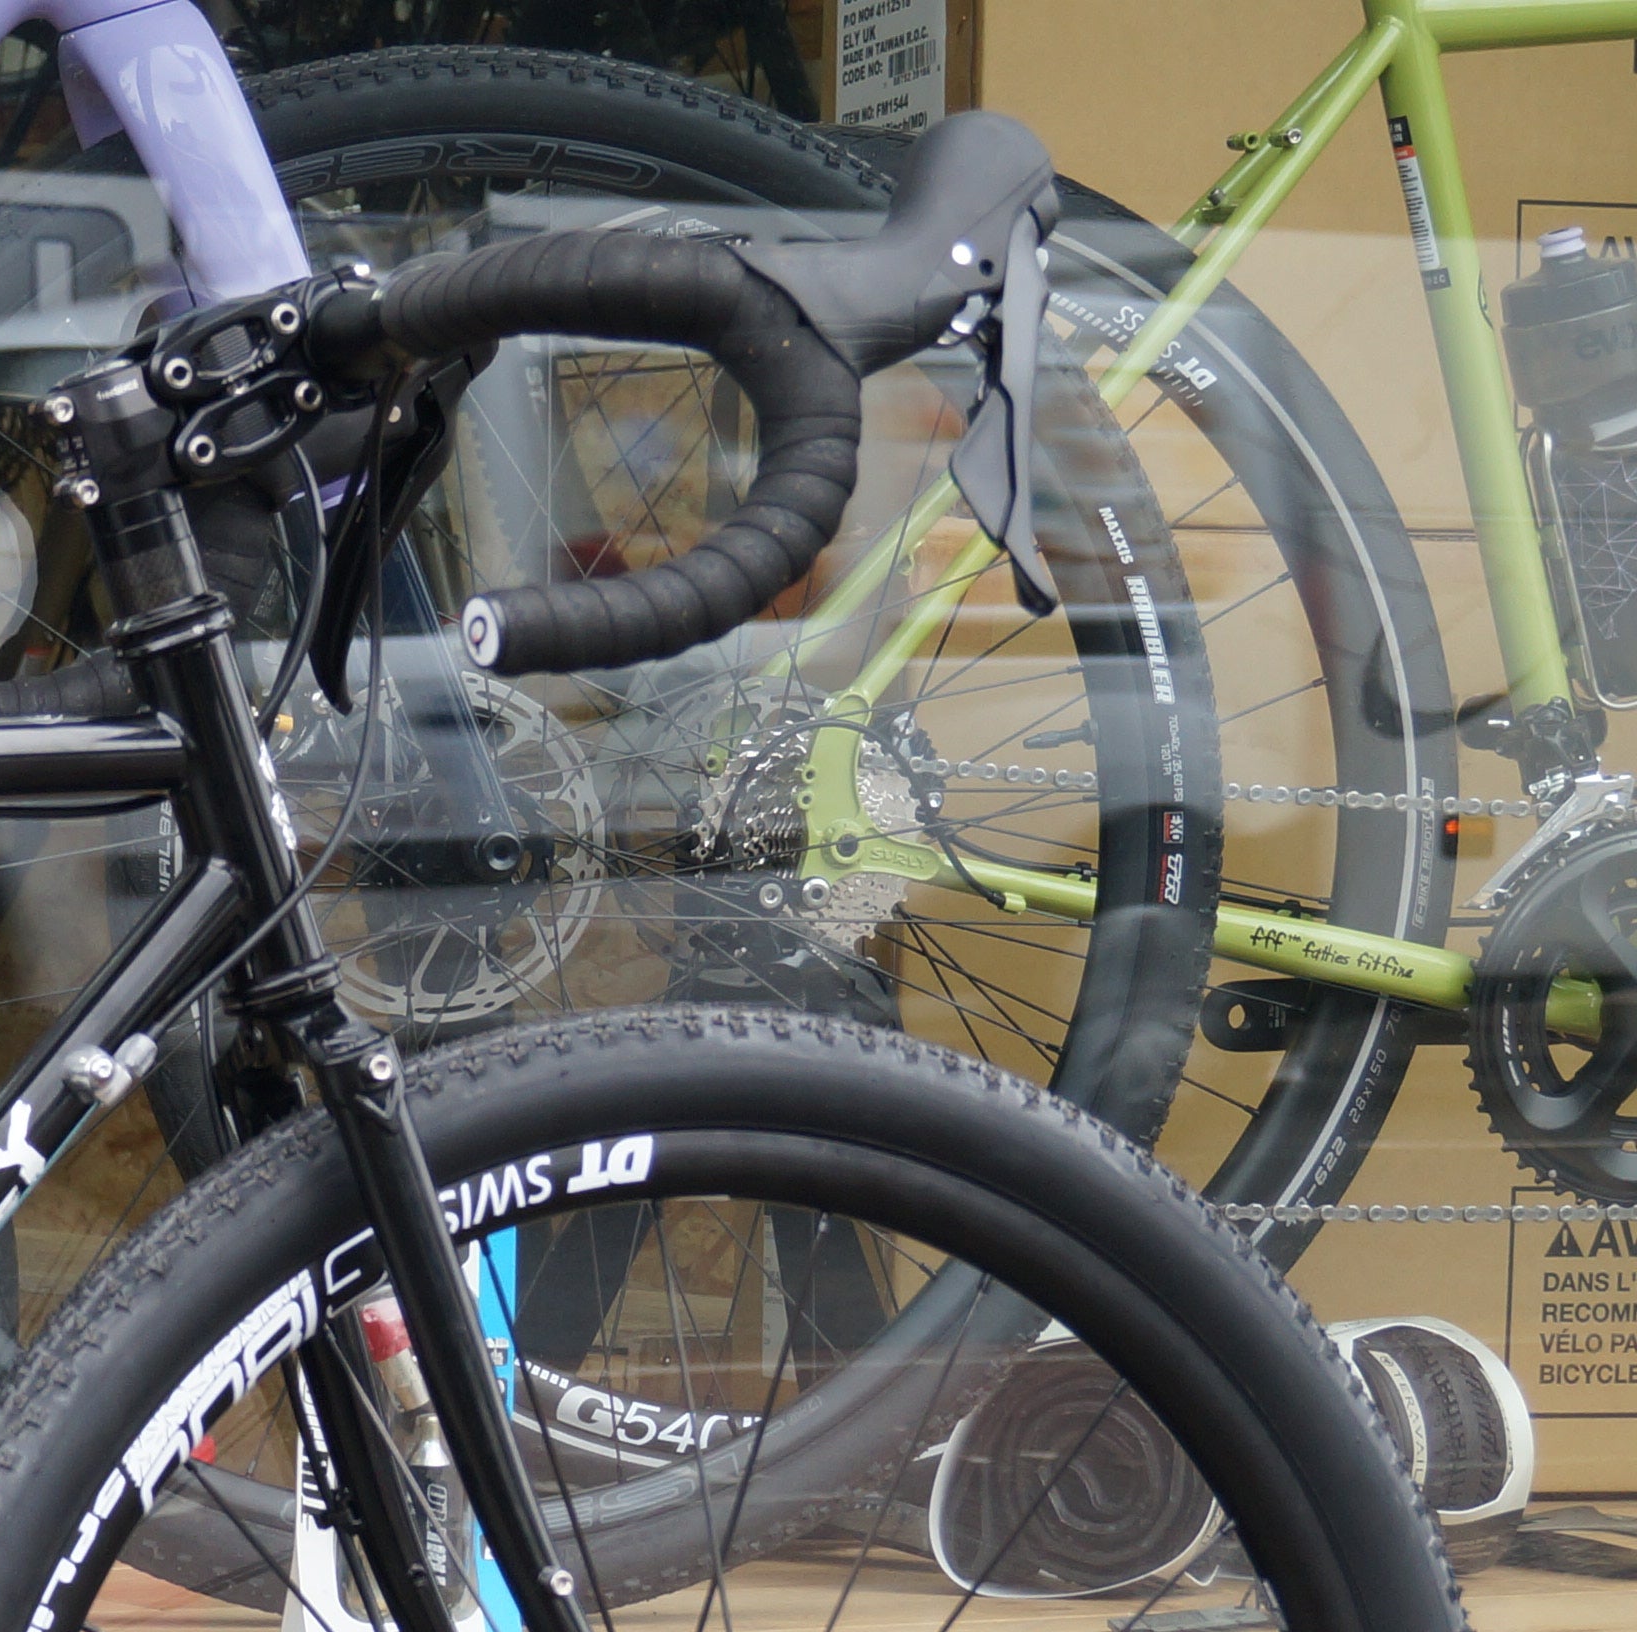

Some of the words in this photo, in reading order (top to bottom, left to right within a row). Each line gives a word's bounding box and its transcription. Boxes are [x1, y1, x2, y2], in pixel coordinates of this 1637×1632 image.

[843, 31, 859, 50] ELY
[863, 25, 876, 42] UK
[843, 49, 863, 66] MADE
[865, 46, 873, 58] IN
[876, 34, 904, 56] TAIWAN
[842, 65, 866, 86] CODE
[868, 60, 883, 78] NO:
[1113, 305, 1181, 359] SSS
[1174, 357, 1217, 391] DT
[1098, 507, 1134, 566] MAXXIS
[1124, 575, 1175, 704] RAMBLER
[567, 1136, 653, 1194] DT
[1543, 1272, 1609, 1292] DANS
[1540, 1328, 1603, 1353] VÉLO
[1390, 1362, 1426, 1488] TERAVAIL
